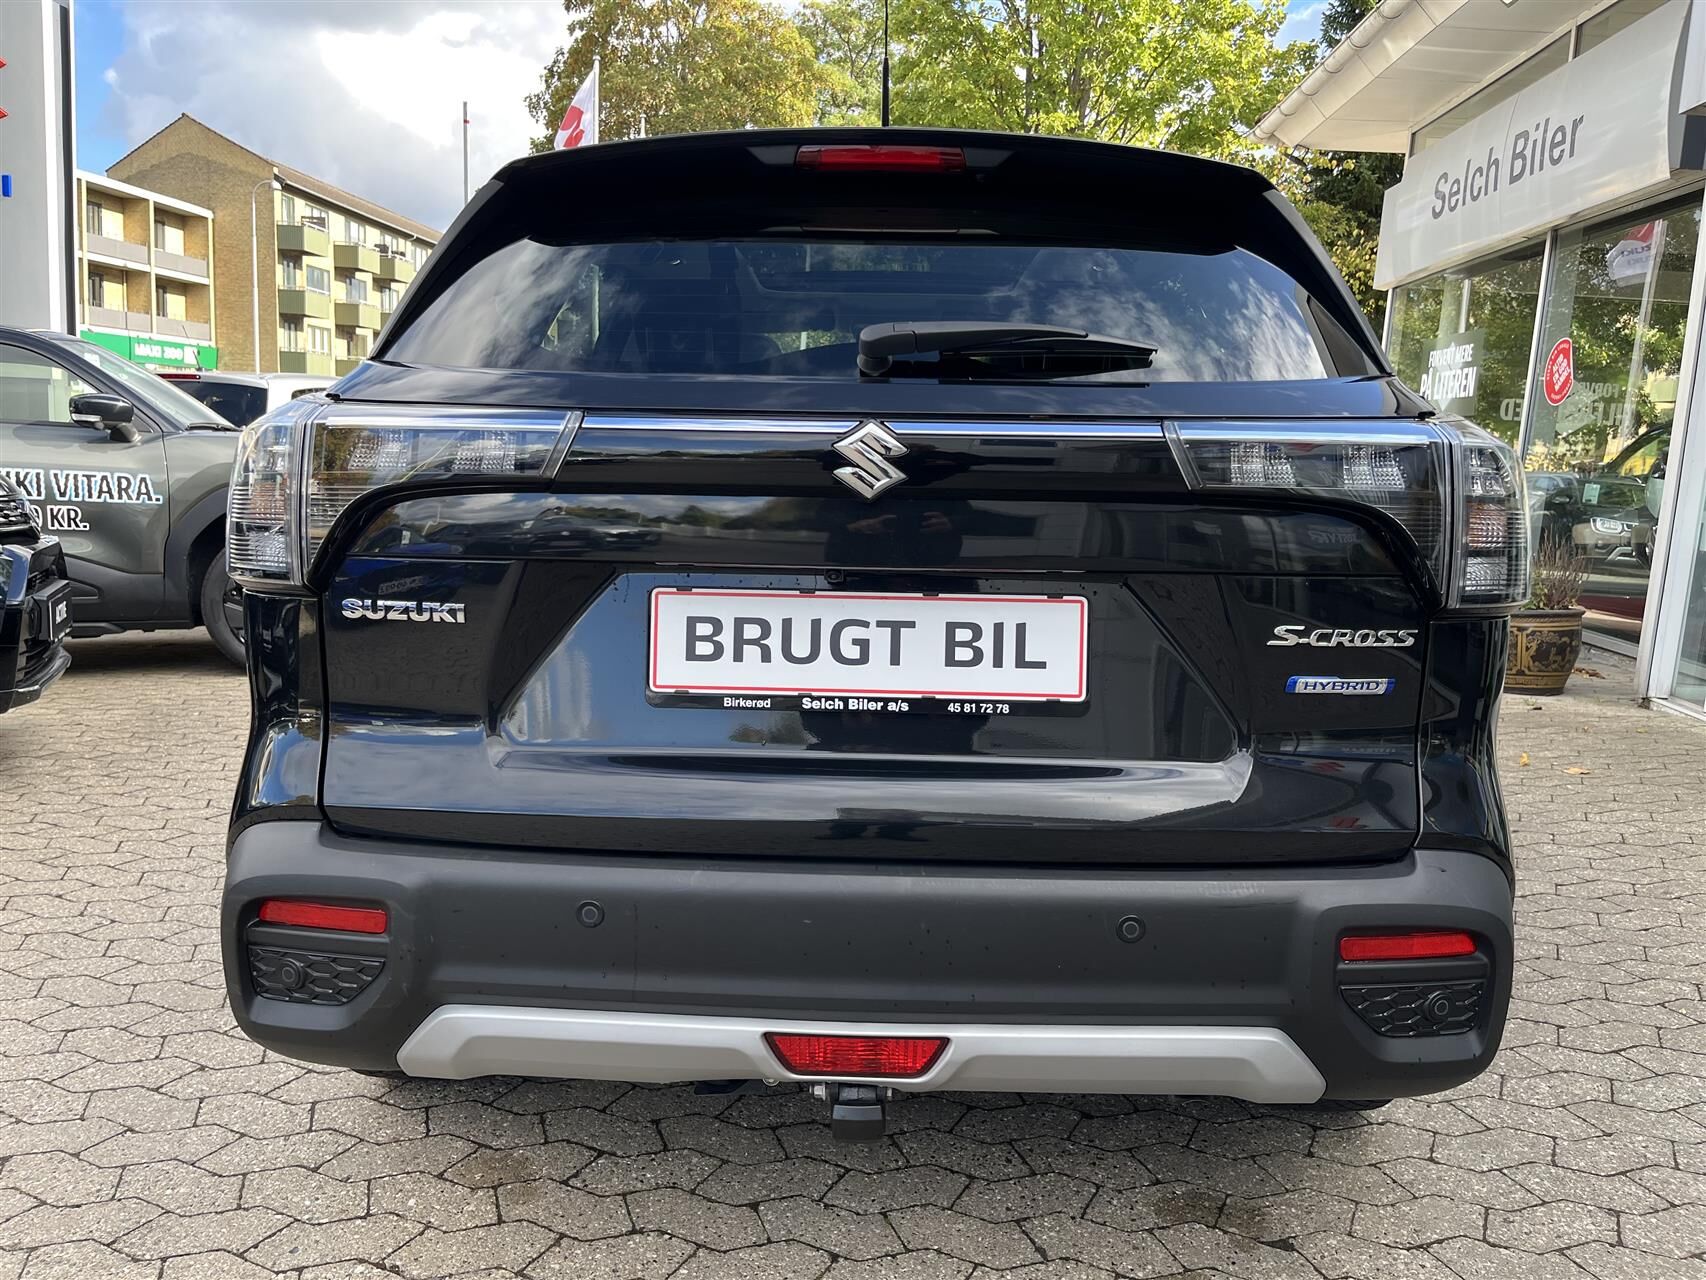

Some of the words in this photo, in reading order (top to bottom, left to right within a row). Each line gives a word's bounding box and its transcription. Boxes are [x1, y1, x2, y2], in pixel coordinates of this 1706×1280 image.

[1432, 147, 1500, 220] Selch
[1509, 114, 1585, 185] Biler
[52, 471, 162, 503] VITARA.
[48, 506, 88, 529] KR.
[341, 598, 466, 623] SUZUKI
[685, 615, 917, 666] BRUGT
[944, 621, 1048, 670] BIL
[1266, 625, 1419, 647] S-CROSS
[1303, 680, 1381, 692] HYBRID
[723, 697, 771, 709] Birkerød
[801, 697, 844, 710] Selch
[848, 699, 884, 711] Biler
[887, 700, 909, 712] a/s
[947, 702, 961, 713] 45
[963, 703, 976, 713] 81
[979, 703, 993, 714] 72
[996, 703, 1010, 714] 78
